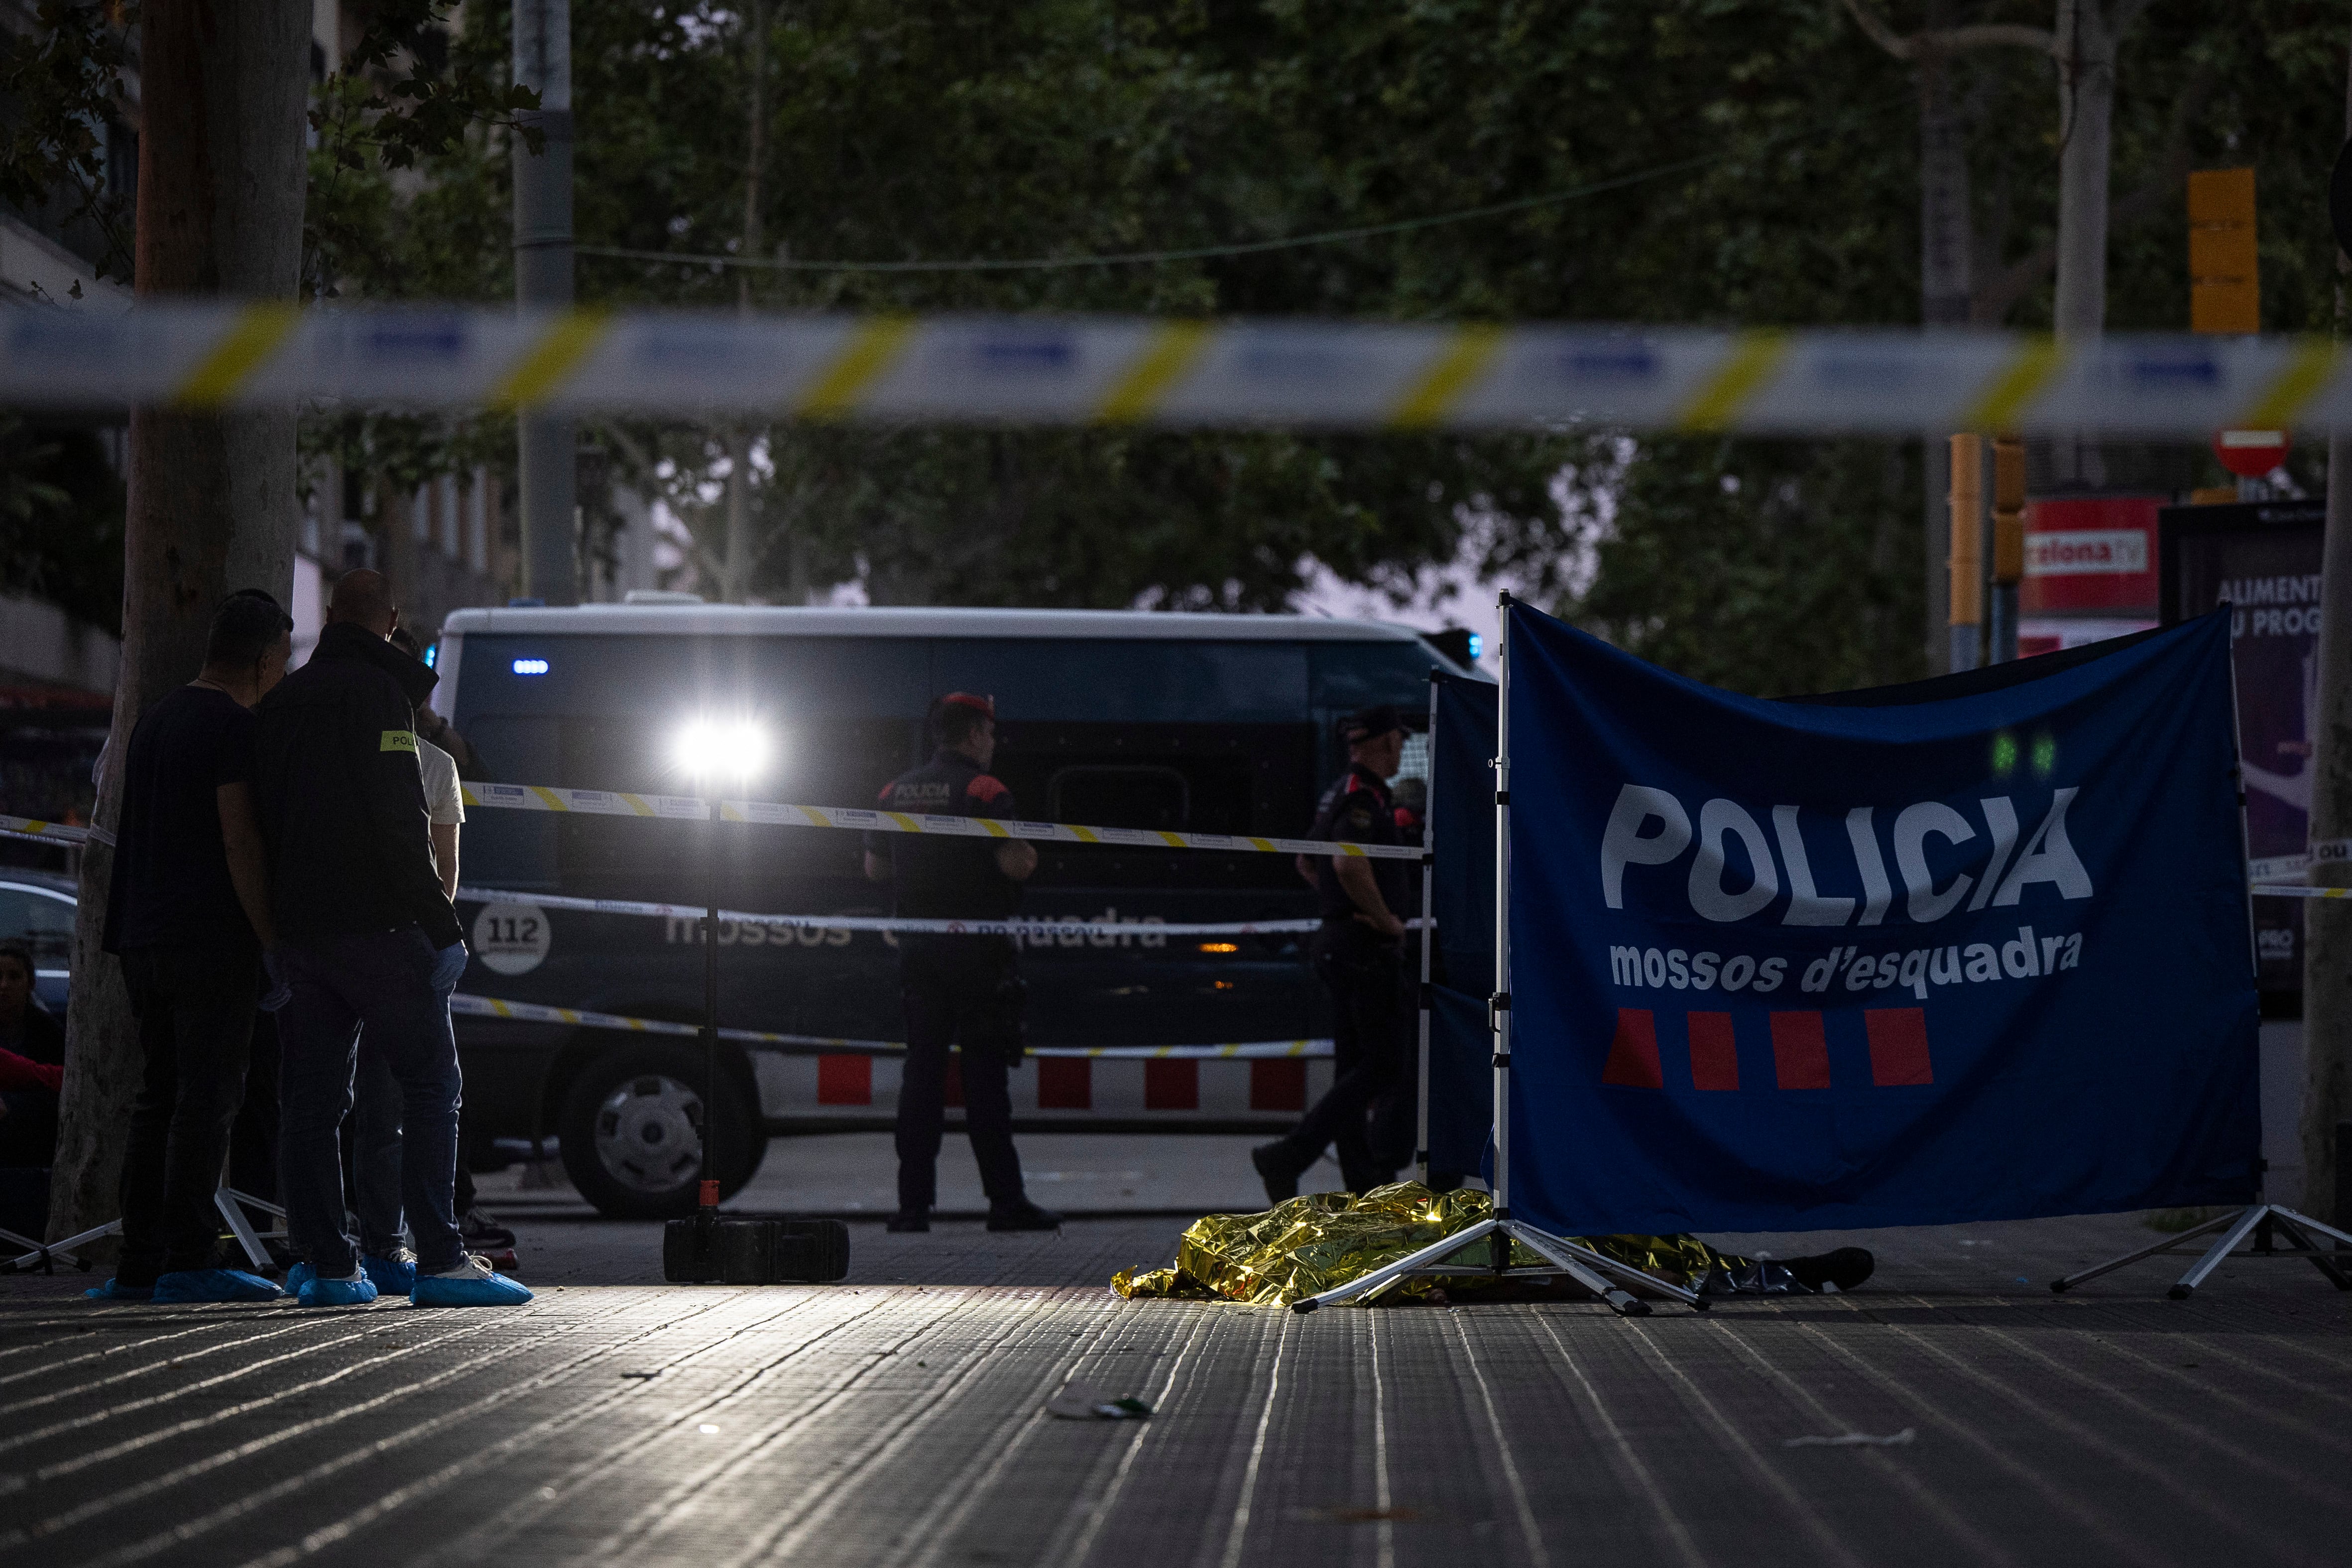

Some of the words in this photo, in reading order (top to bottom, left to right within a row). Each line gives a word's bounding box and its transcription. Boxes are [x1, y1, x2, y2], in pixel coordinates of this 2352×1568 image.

[2253, 605, 2320, 637] PROG
[393, 736, 414, 746] POL
[1601, 783, 2093, 926] POLICIA
[487, 918, 539, 944] 112
[1610, 944, 1788, 993] mossos
[1801, 925, 2084, 1000] d'esquadra
